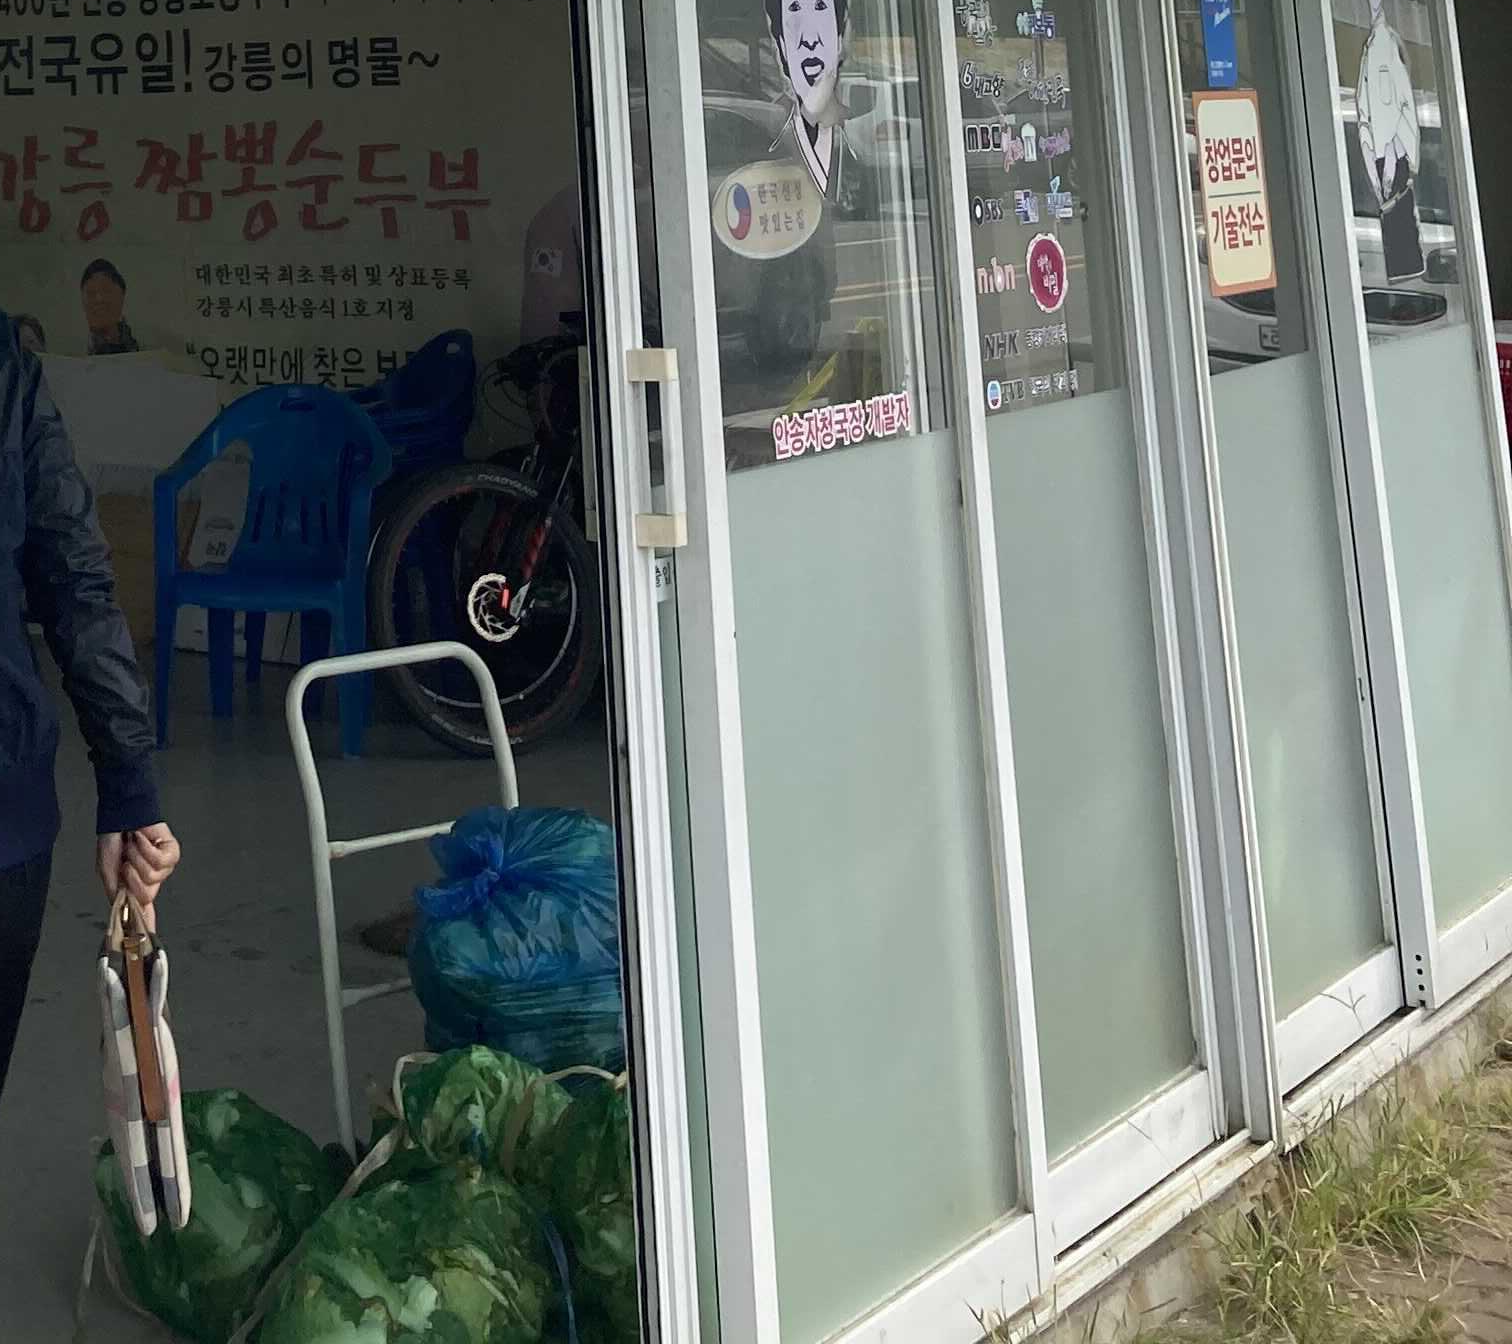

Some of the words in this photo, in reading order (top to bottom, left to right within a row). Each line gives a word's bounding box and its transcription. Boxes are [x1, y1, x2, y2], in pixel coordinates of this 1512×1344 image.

[204, 39, 314, 92] 강릉의
[328, 35, 439, 89] 명물~
[134, 120, 491, 241] 짬뽕순두부
[1205, 137, 1259, 183] 창업문의
[1211, 203, 1265, 251] 기술전수
[195, 263, 270, 287] 대한민국
[277, 263, 315, 287] 최초
[319, 264, 358, 287] 특허
[365, 264, 381, 287] 및
[387, 265, 473, 290] 상표등록
[195, 296, 252, 319] 강릉시
[258, 296, 336, 319] 특산음식
[343, 298, 370, 318] 1호
[376, 298, 415, 321] 지정
[984, 330, 1020, 360] NHK
[774, 403, 864, 455] 안송자청국장
[866, 392, 910, 435] 개발자
